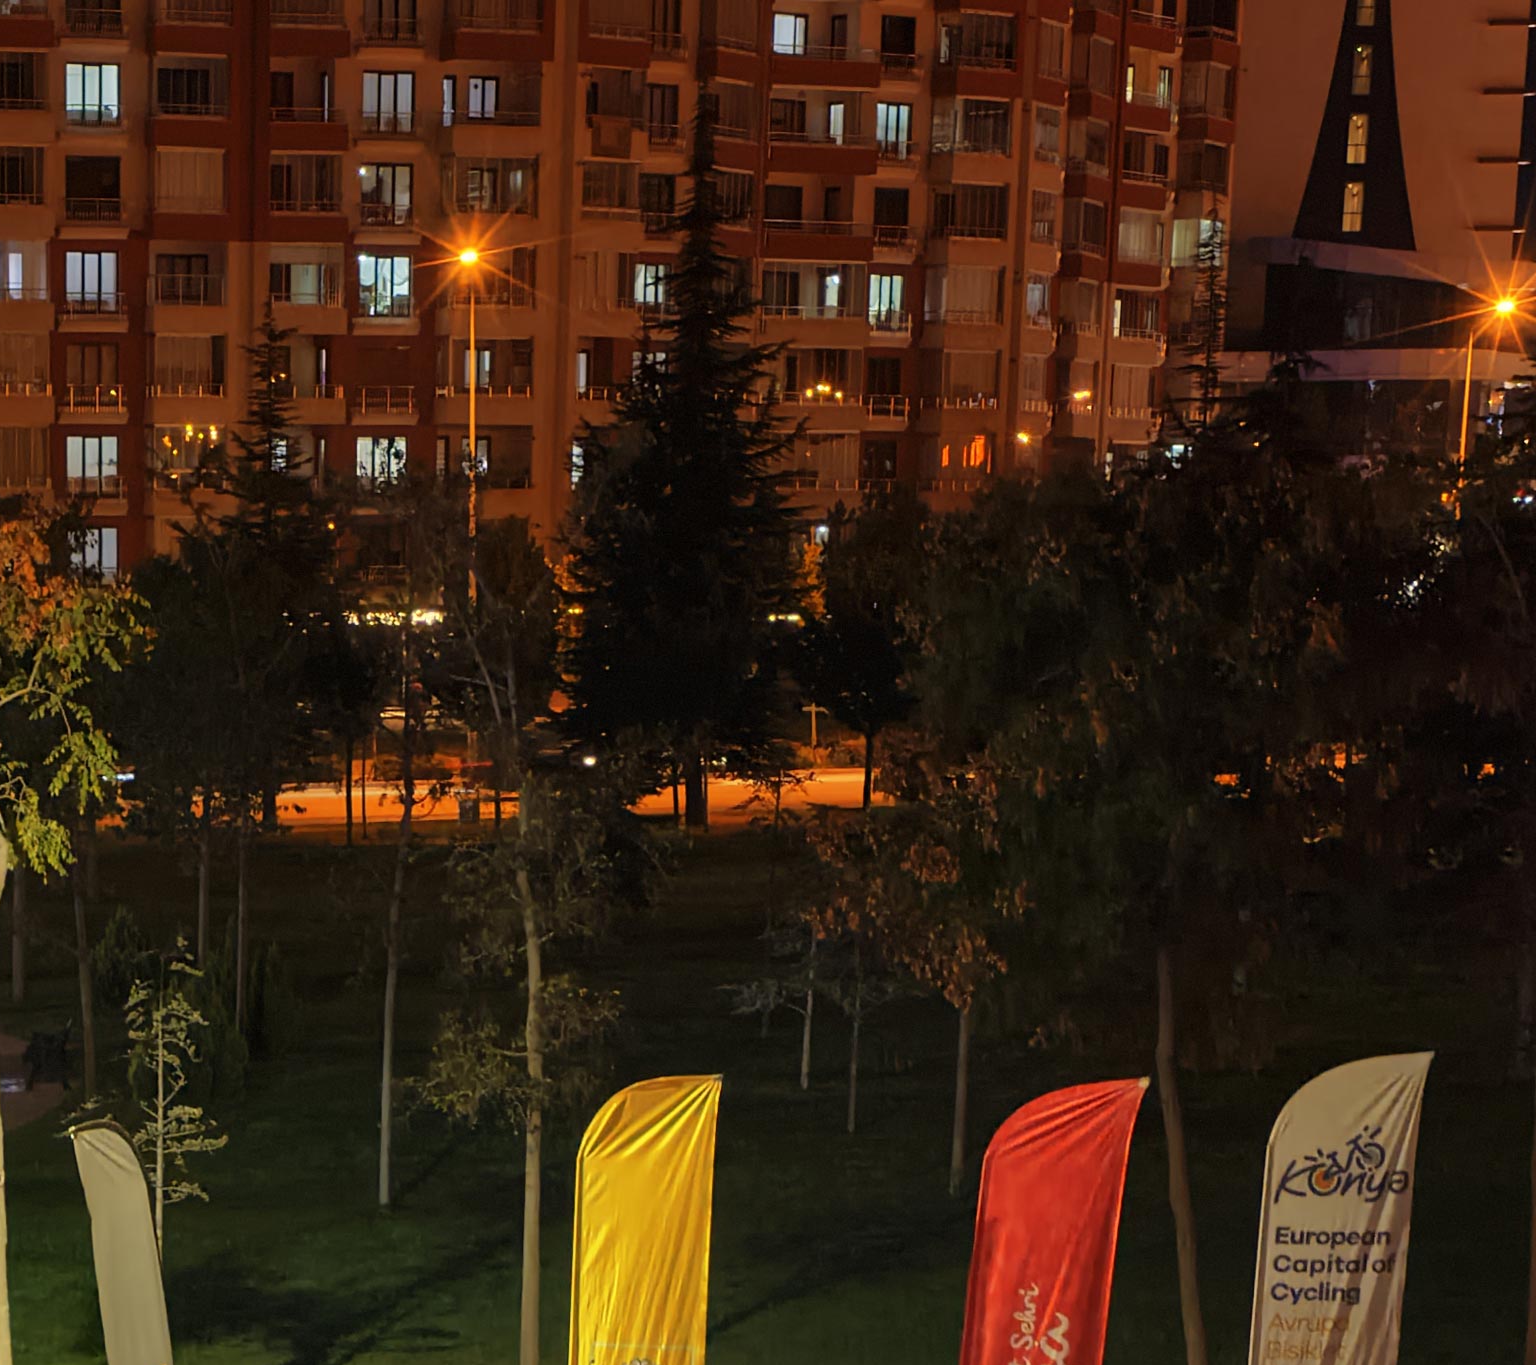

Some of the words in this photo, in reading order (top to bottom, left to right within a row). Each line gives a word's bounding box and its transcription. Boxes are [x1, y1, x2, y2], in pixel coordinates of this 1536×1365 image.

[1275, 1226, 1391, 1249] European
[1273, 1253, 1368, 1278] Capital
[1372, 1253, 1396, 1274] of
[1270, 1282, 1361, 1305] Cycling
[1269, 1312, 1349, 1335] Avrupa
